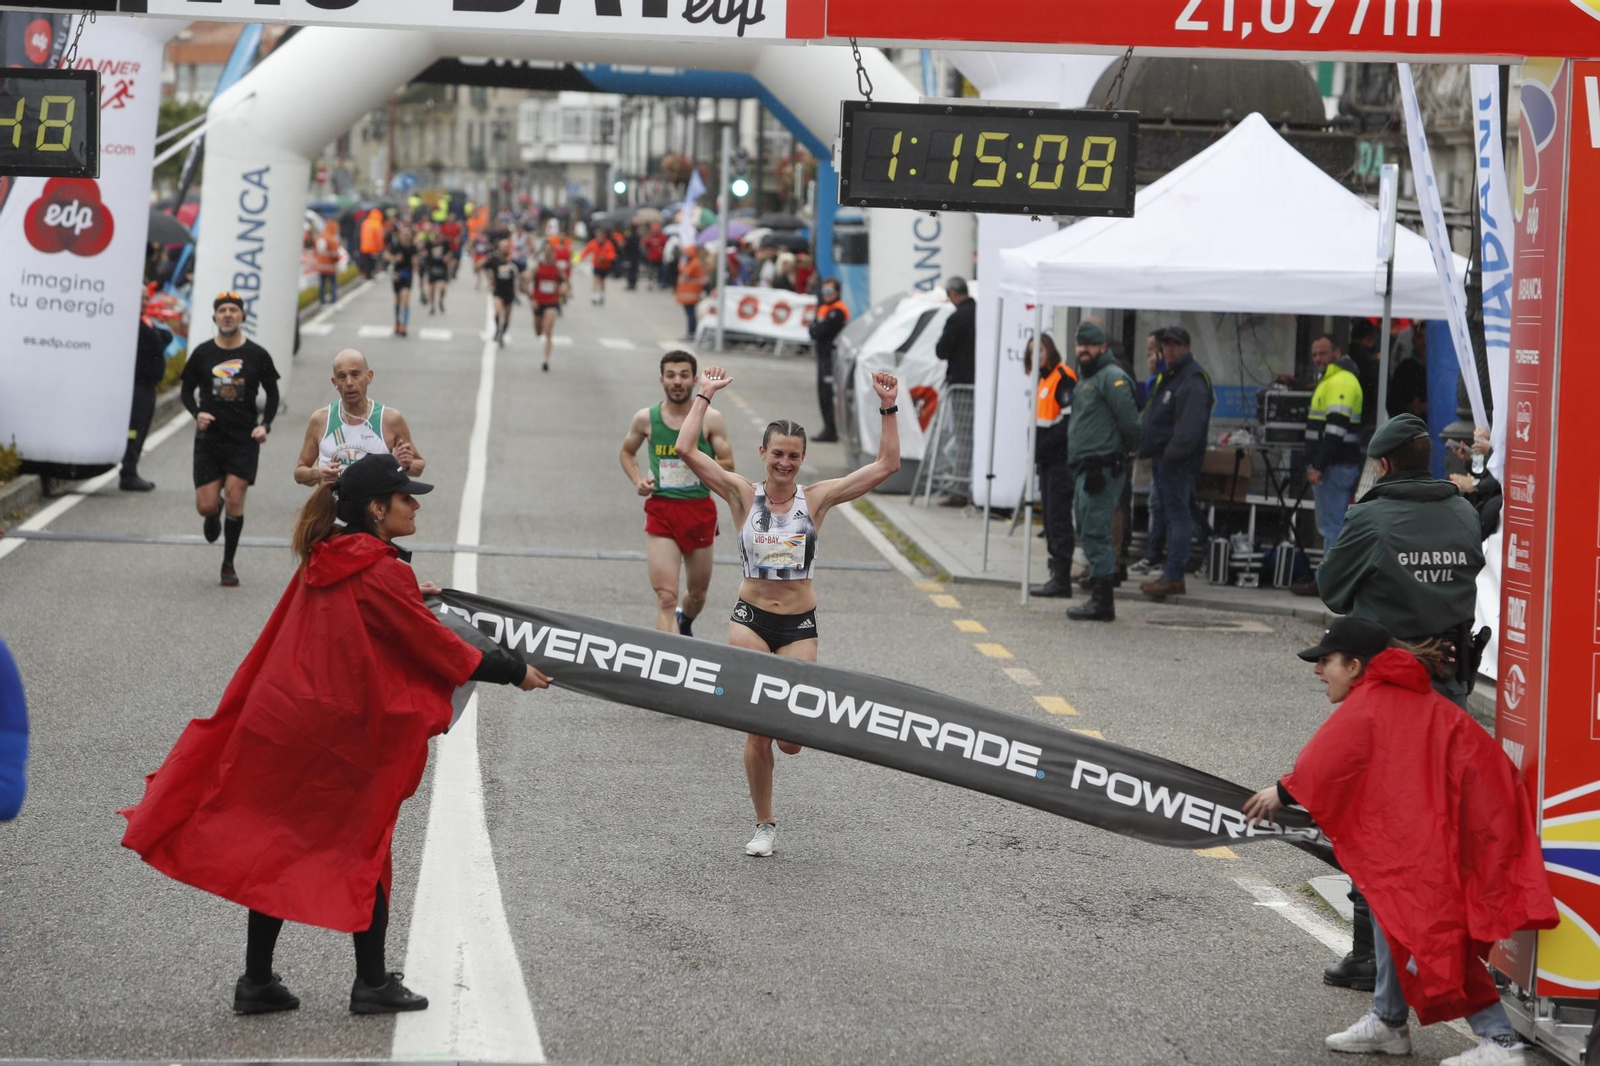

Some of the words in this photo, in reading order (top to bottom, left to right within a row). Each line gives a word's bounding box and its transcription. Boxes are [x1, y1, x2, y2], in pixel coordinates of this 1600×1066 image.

[887, 130, 1117, 191] 1:15:08
[44, 199, 93, 236] edp
[21, 269, 105, 293] imagina
[10, 292, 28, 307] tu
[1398, 551, 1467, 566] GUARDIA
[1414, 569, 1453, 583] CIVIL
[750, 673, 1043, 778] POWERADE
